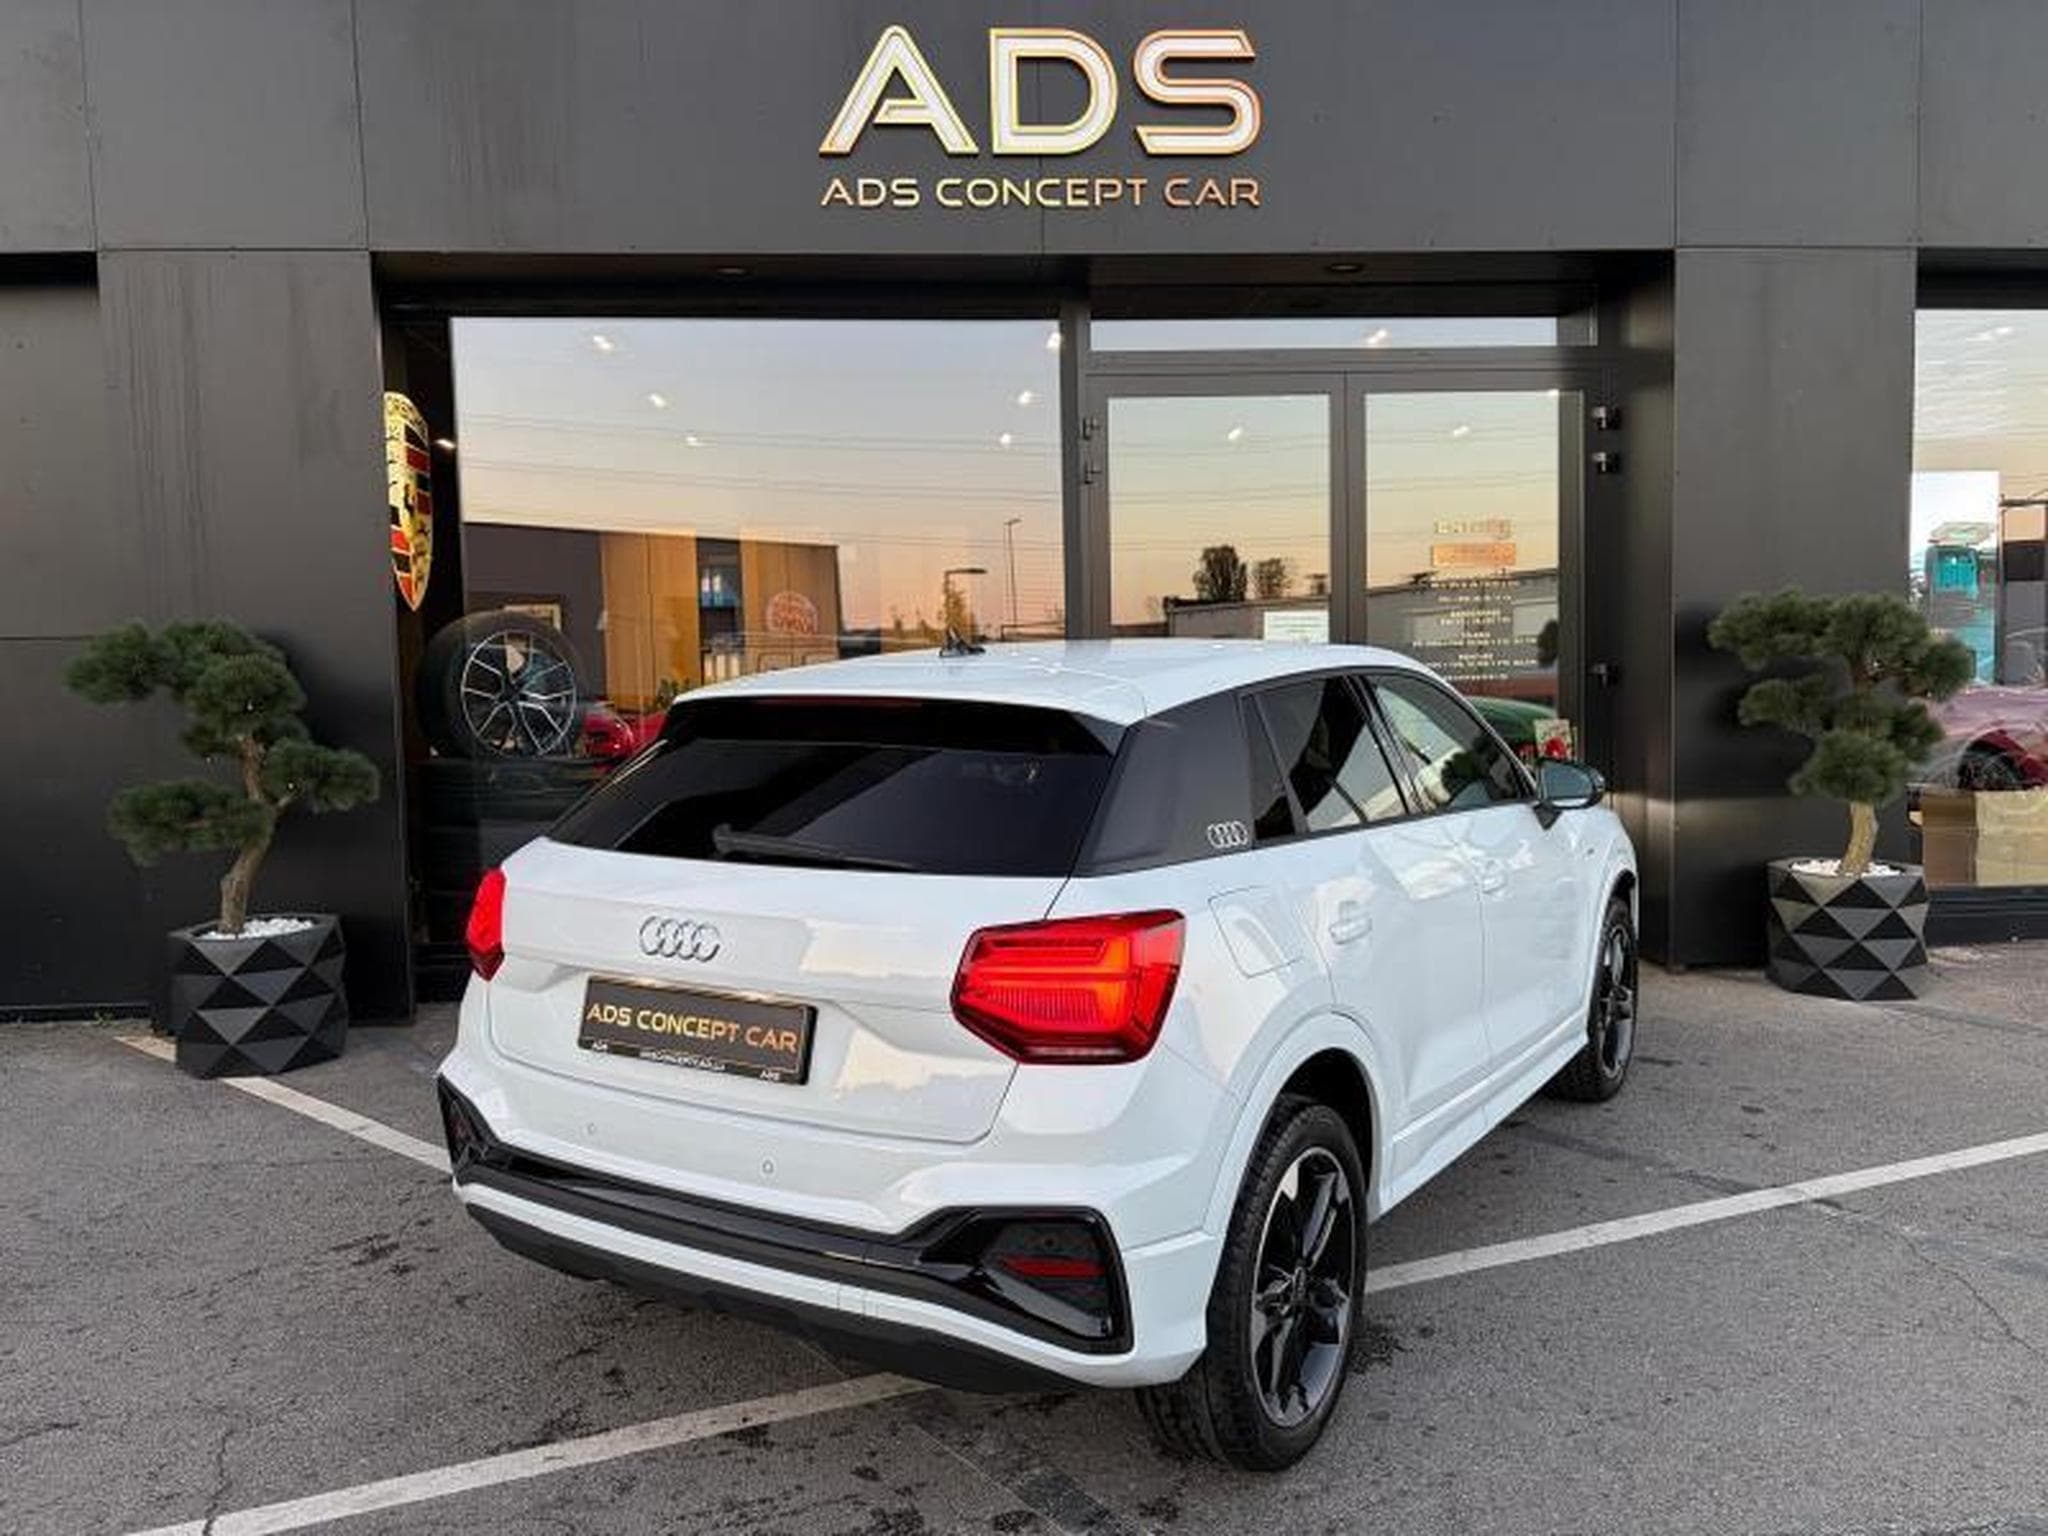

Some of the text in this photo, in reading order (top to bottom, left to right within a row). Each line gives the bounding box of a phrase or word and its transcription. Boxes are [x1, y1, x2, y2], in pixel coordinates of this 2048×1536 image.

[818, 24, 1262, 155] ADS
[820, 178, 1261, 208] ADS CONCEPT CAR
[586, 1003, 798, 1052] ADS CONCEPT CAR
